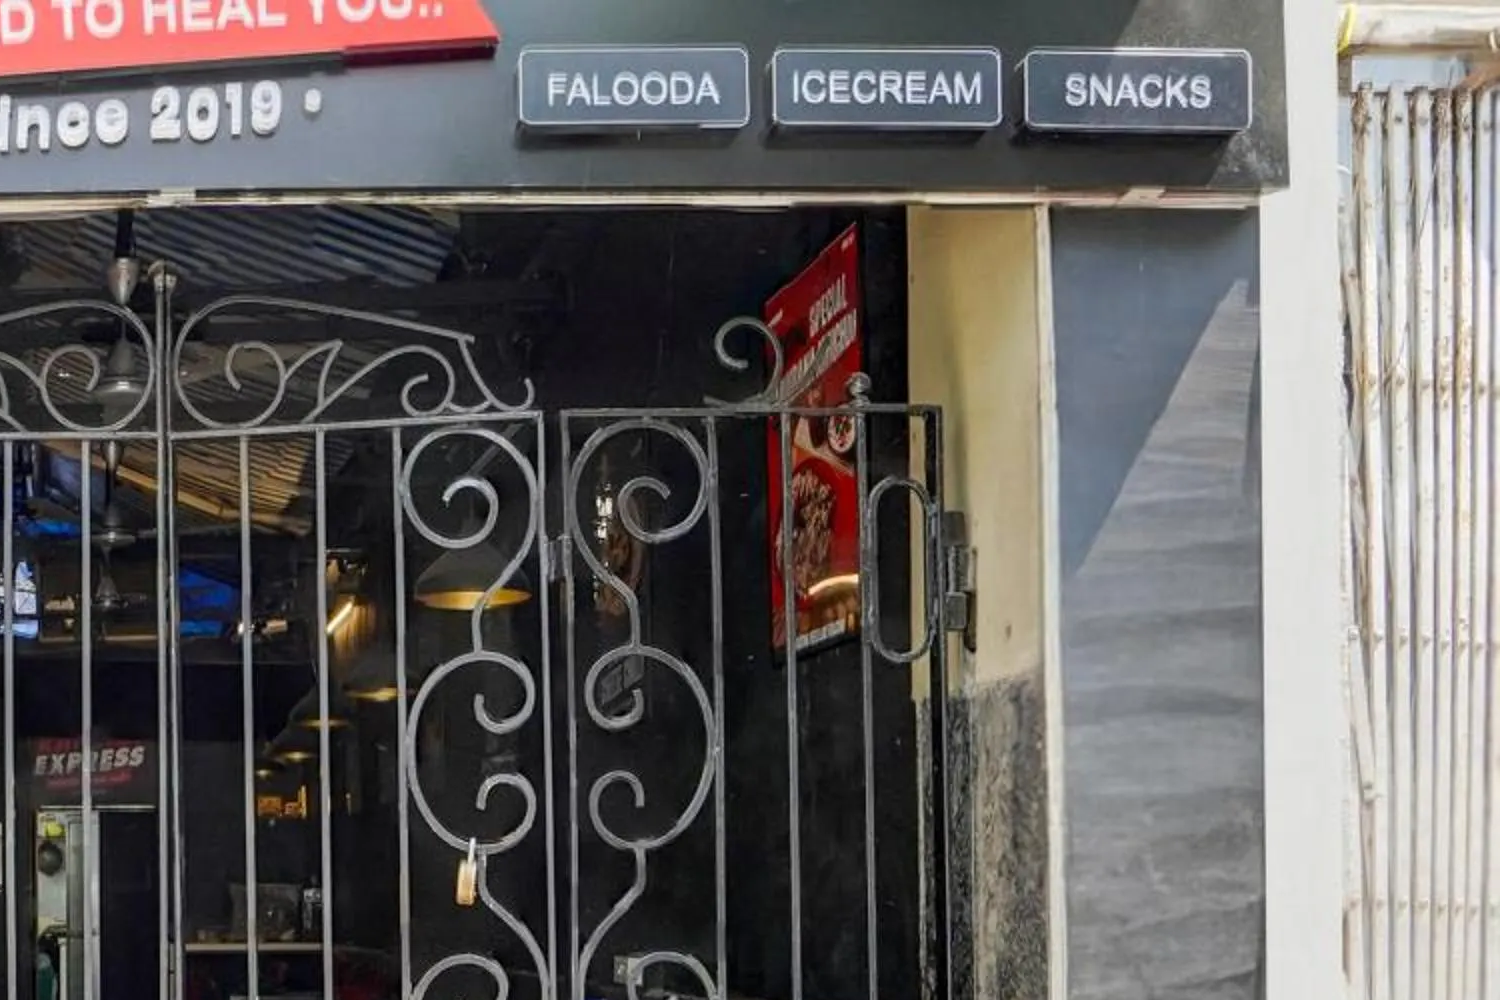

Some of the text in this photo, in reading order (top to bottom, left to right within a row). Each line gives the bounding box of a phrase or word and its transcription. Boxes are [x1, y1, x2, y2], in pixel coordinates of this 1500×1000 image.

[51, 0, 125, 41] TO
[143, 0, 288, 35] HEAL
[546, 71, 722, 107] FALOODA
[792, 69, 983, 106] ICECREAM
[1063, 73, 1213, 110] SNACKS
[149, 79, 284, 143] 2019
